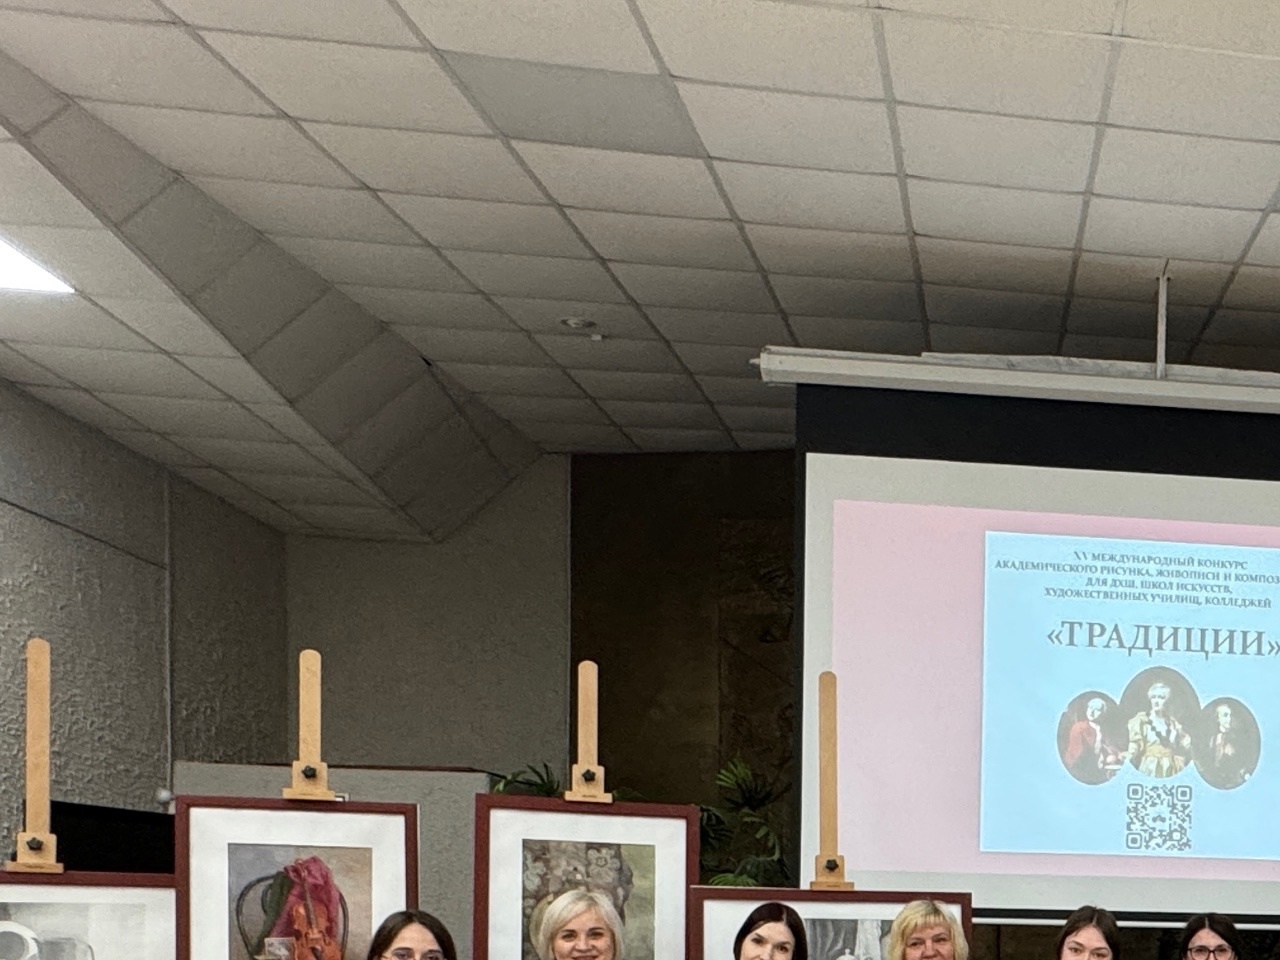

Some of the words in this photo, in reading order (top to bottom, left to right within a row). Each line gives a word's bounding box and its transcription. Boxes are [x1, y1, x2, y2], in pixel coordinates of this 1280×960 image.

[995, 559, 1098, 575] АКАДЕМИЧЕСКОГО
[1155, 569, 1221, 582] ЖИВОПИСИ
[1091, 552, 1195, 568] МЕЖДУНАРОДНЫЙ
[1198, 558, 1249, 570] КОНКУРС
[1085, 576, 1108, 587] ДЛЯ
[1140, 580, 1174, 591] ШКОЛ
[1044, 587, 1149, 602] ХУДОЖЕСТВЕННЫХ
[1205, 596, 1272, 609] КОЛЛЕДЖЕЙ
